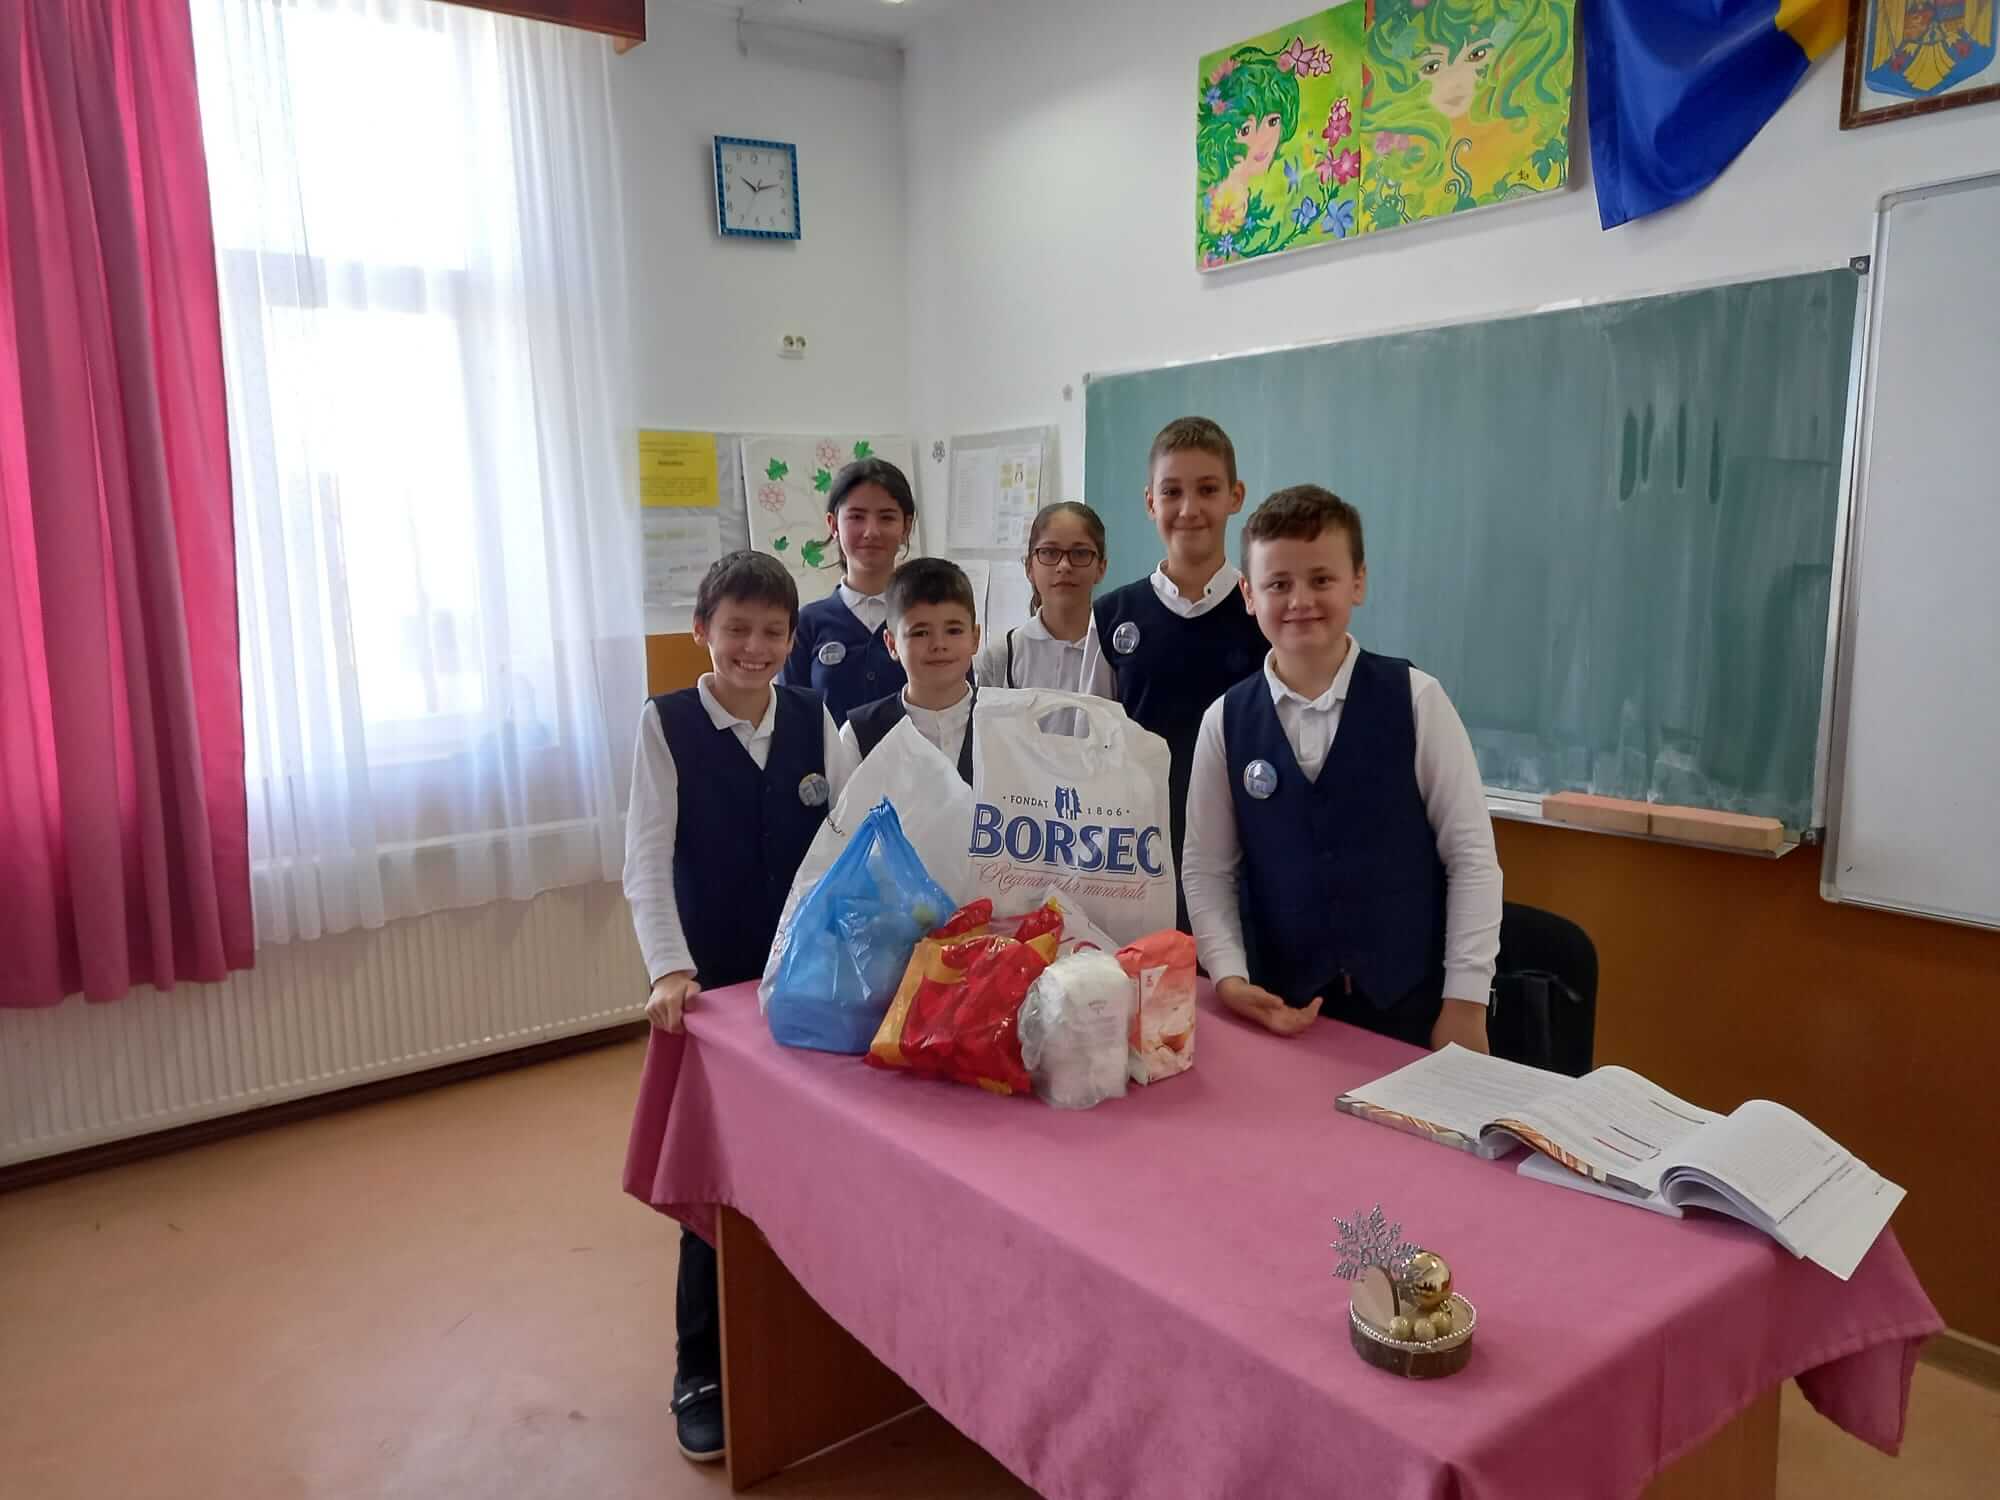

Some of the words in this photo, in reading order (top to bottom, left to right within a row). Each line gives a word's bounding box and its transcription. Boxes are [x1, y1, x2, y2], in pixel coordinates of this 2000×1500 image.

[1010, 795, 1049, 808] FONDAT
[1087, 806, 1122, 816] 1806
[968, 803, 1163, 878] BORSEC
